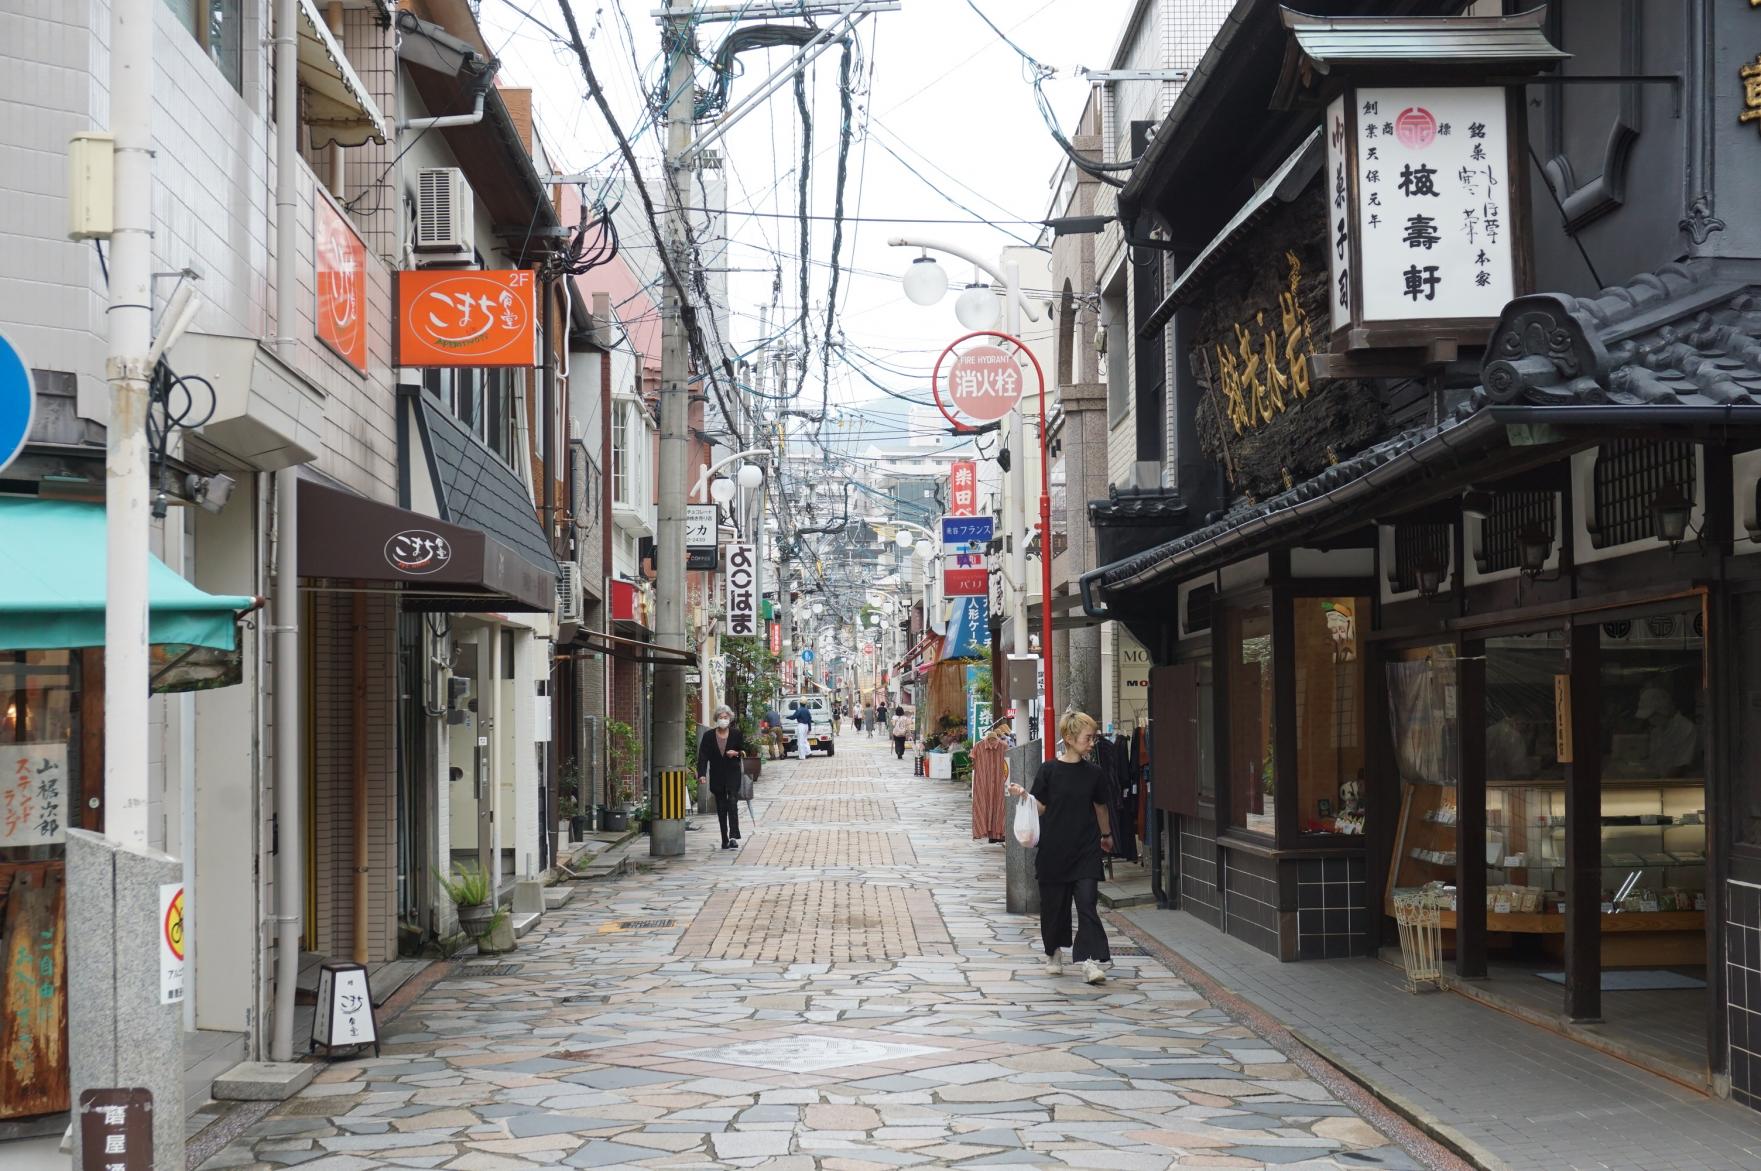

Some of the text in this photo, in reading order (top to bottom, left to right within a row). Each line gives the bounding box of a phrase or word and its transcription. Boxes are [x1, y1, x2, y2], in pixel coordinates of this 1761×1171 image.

[1468, 121, 1487, 161] 銘菓
[1363, 100, 1382, 229] 創業天保元年
[508, 272, 529, 287] 2F
[1475, 248, 1492, 288] 本家
[425, 291, 497, 342] こまち
[960, 355, 1010, 365] FIRE HYDRANT
[955, 368, 1018, 398] 消火栓
[392, 535, 436, 565] こまち
[730, 546, 753, 635] よこはま
[959, 579, 982, 590] パリ
[340, 994, 364, 1015] こまち
